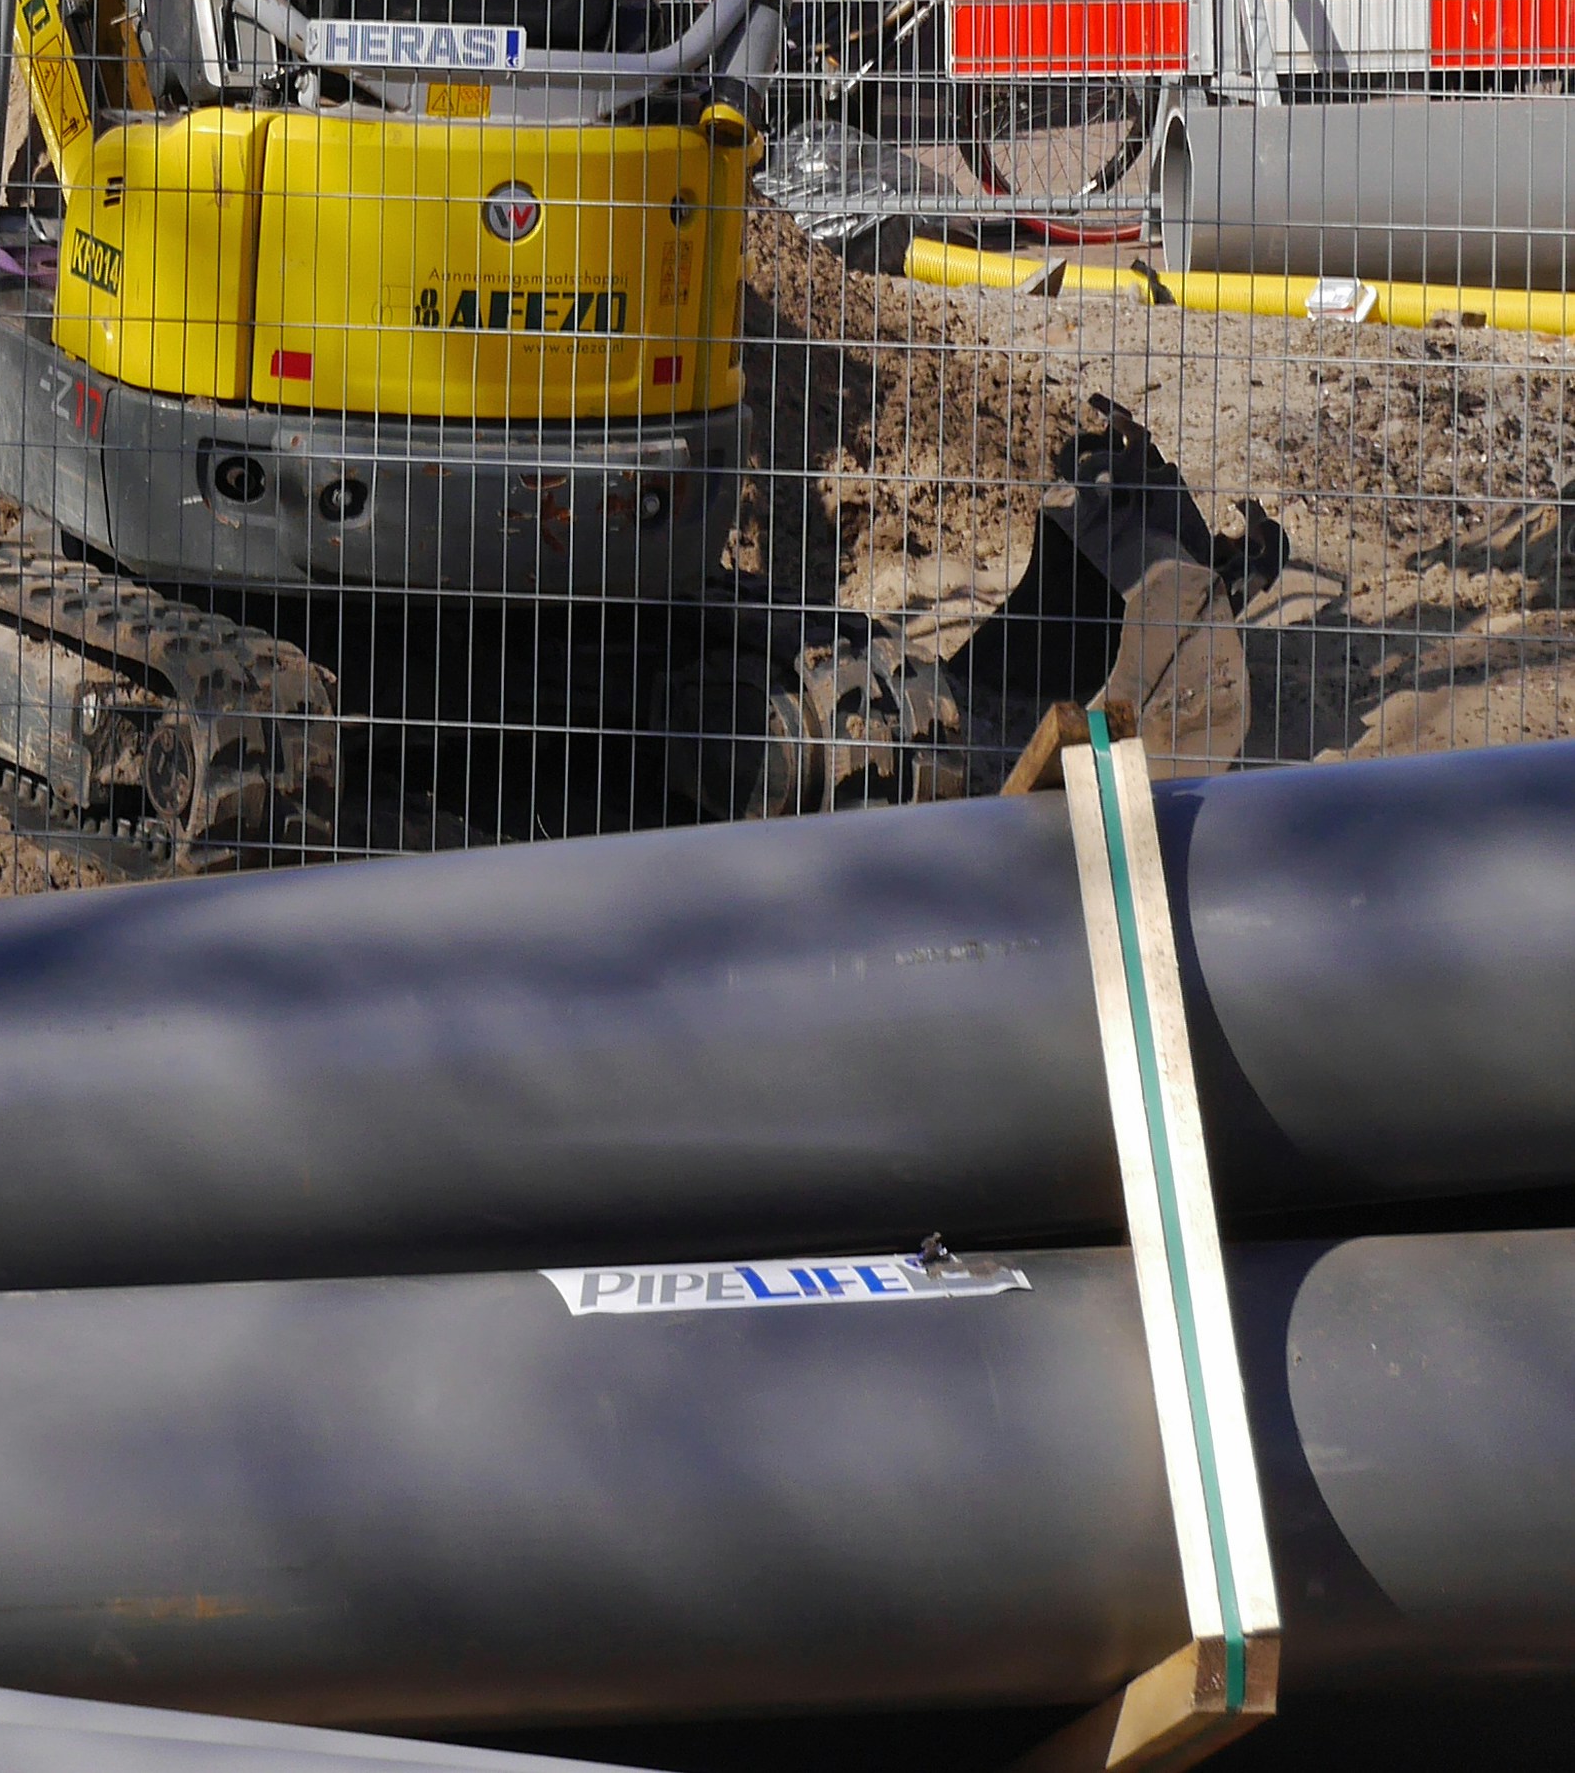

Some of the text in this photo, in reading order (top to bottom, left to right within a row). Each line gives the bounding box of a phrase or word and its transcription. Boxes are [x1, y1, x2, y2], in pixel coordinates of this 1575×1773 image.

[325, 23, 497, 67] HERAS
[449, 289, 628, 334] AFEZO
[523, 338, 624, 354] www.afezonl
[579, 1264, 909, 1308] PIPELIFE
